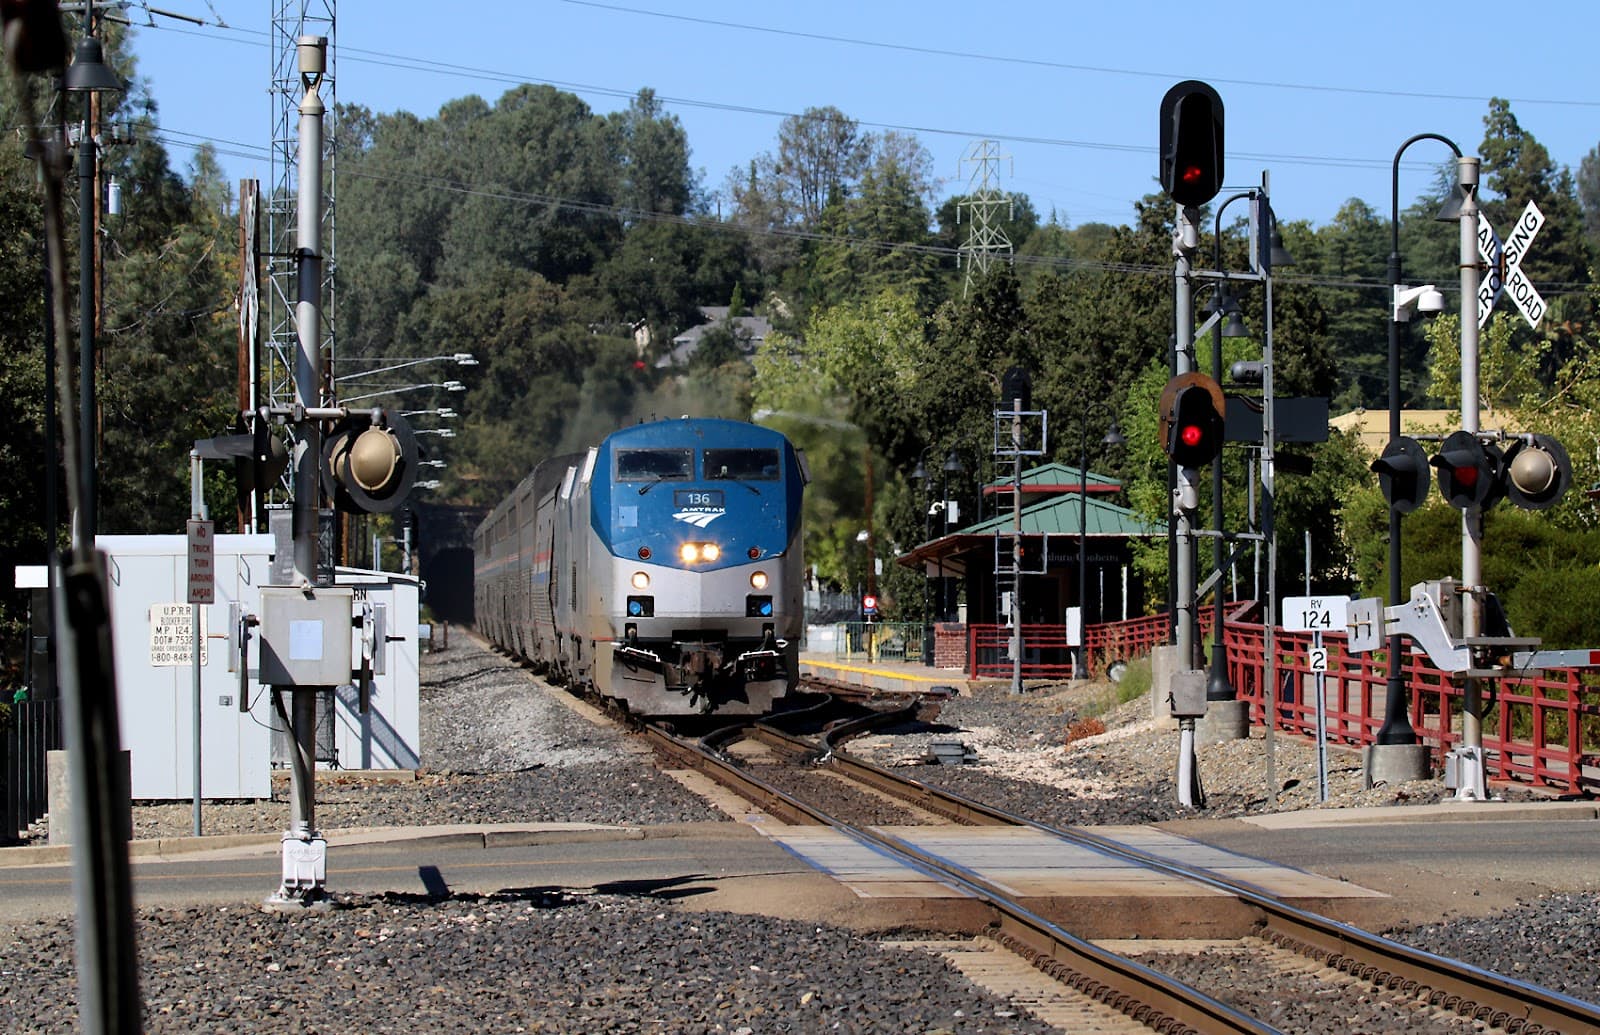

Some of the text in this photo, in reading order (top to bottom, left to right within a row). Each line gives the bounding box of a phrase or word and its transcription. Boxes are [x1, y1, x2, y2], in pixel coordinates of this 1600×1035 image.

[1479, 212, 1538, 320] ROSING
[1479, 222, 1542, 321] AIL ROAD
[688, 493, 710, 504] 136
[197, 527, 206, 538] NO
[192, 544, 210, 553] TRUCK
[194, 559, 209, 568] TURN
[191, 574, 213, 582] AROUND
[192, 588, 211, 597] AHEAD
[354, 588, 366, 600] RN
[1310, 599, 1323, 609] RV
[1302, 610, 1331, 628] 124
[1312, 651, 1325, 670] 2
